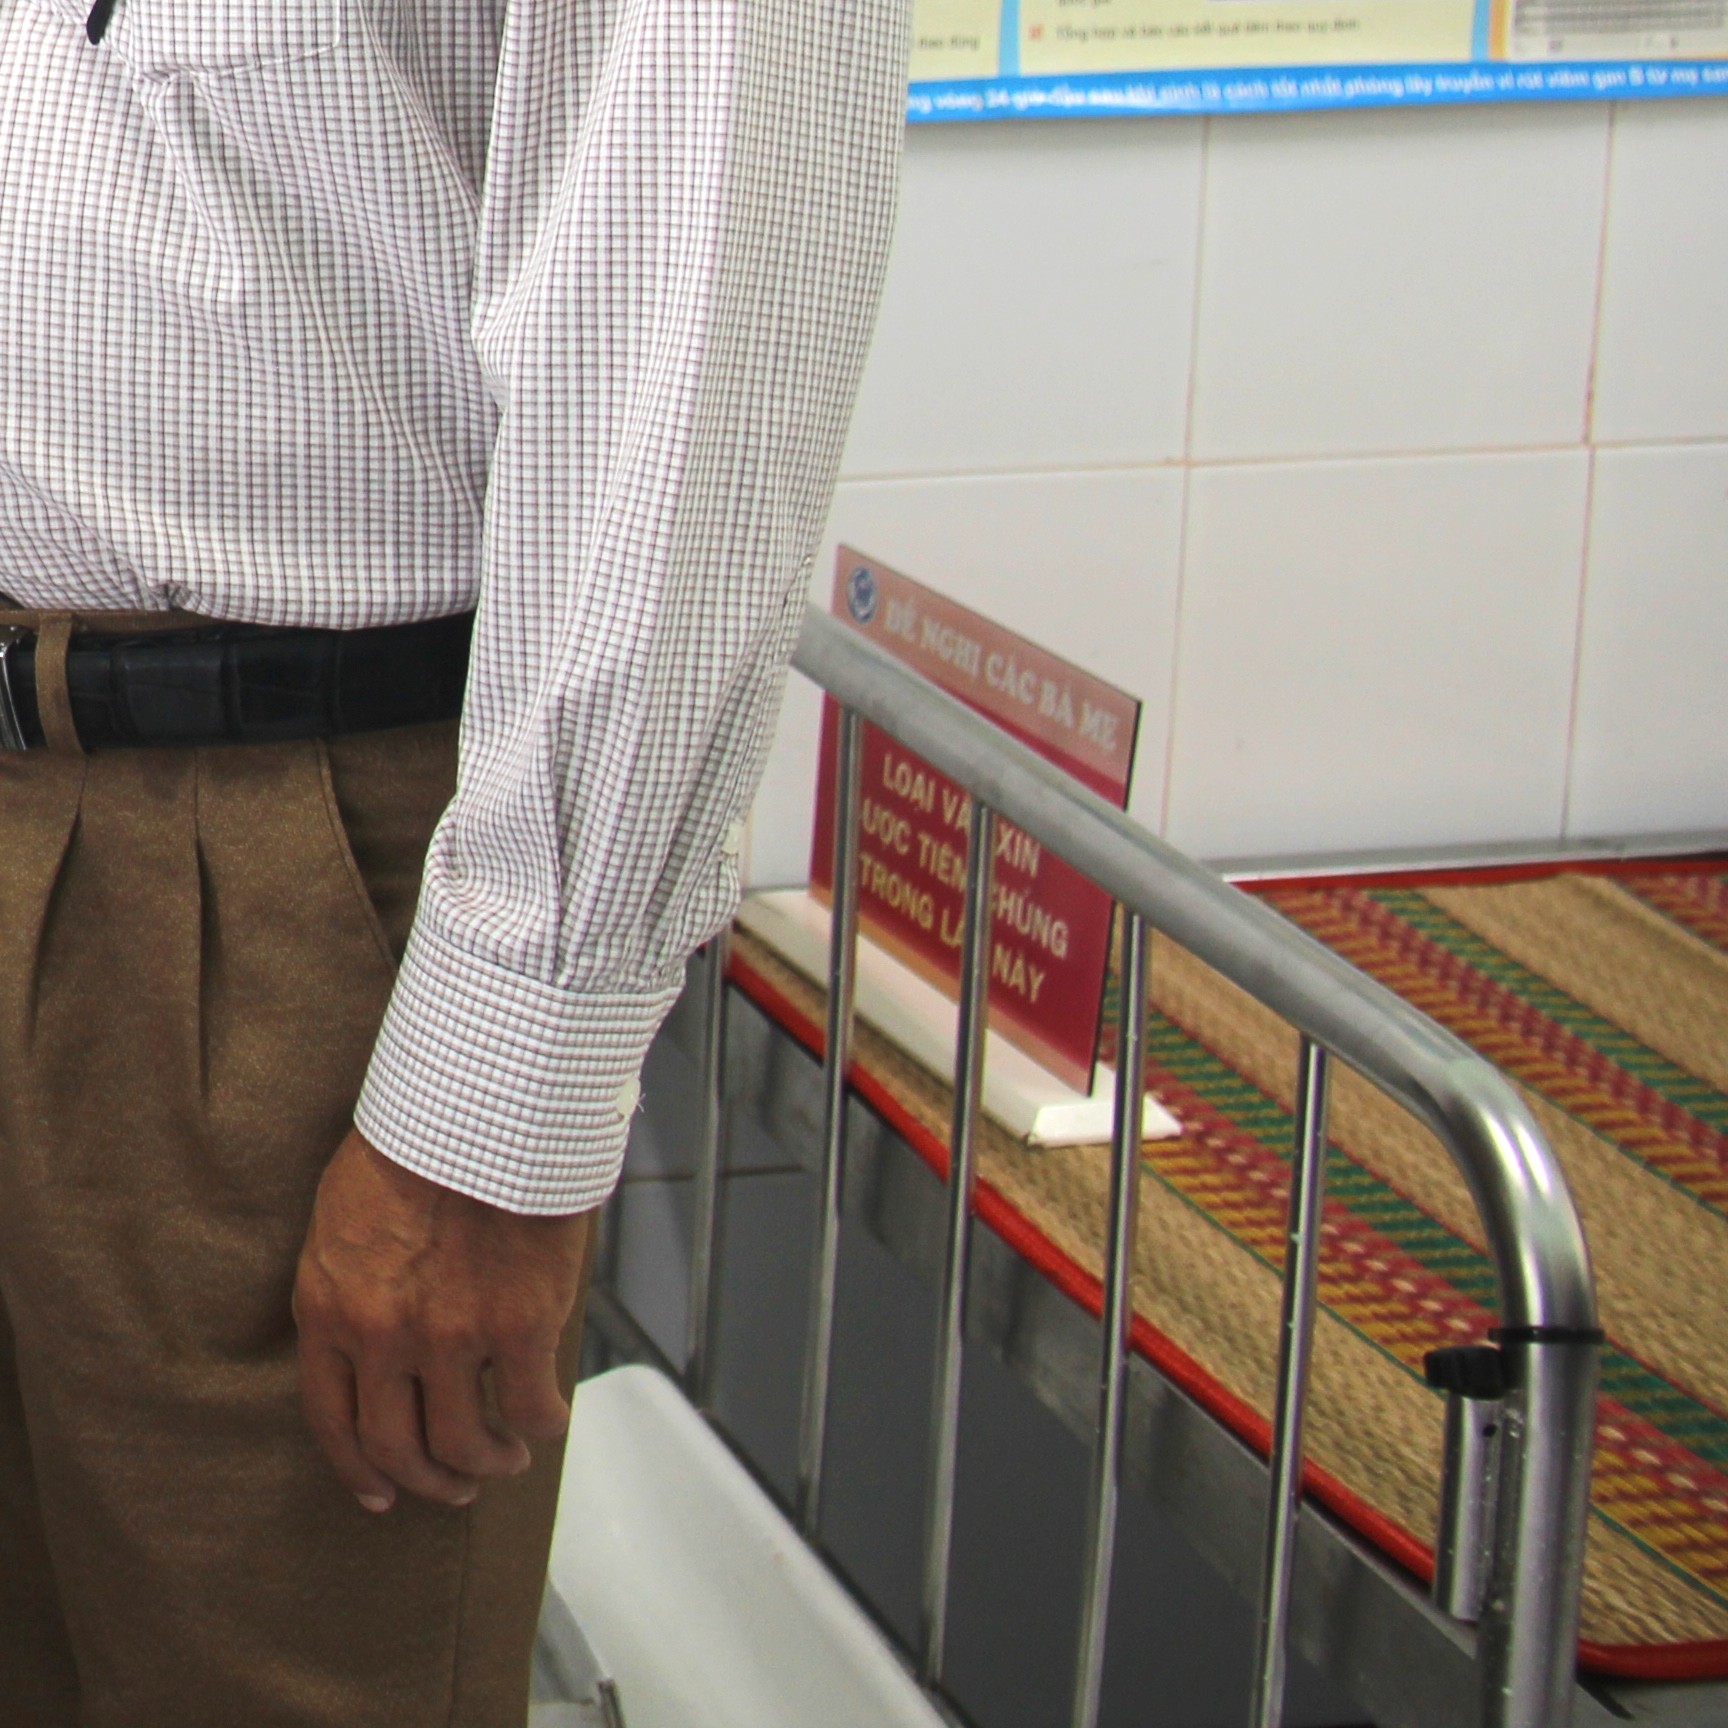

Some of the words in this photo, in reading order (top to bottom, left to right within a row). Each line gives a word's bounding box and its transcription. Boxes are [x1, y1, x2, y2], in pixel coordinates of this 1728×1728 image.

[882, 752, 936, 813] LOẠI
[994, 822, 1041, 879] XIN
[858, 851, 935, 931] TRONG
